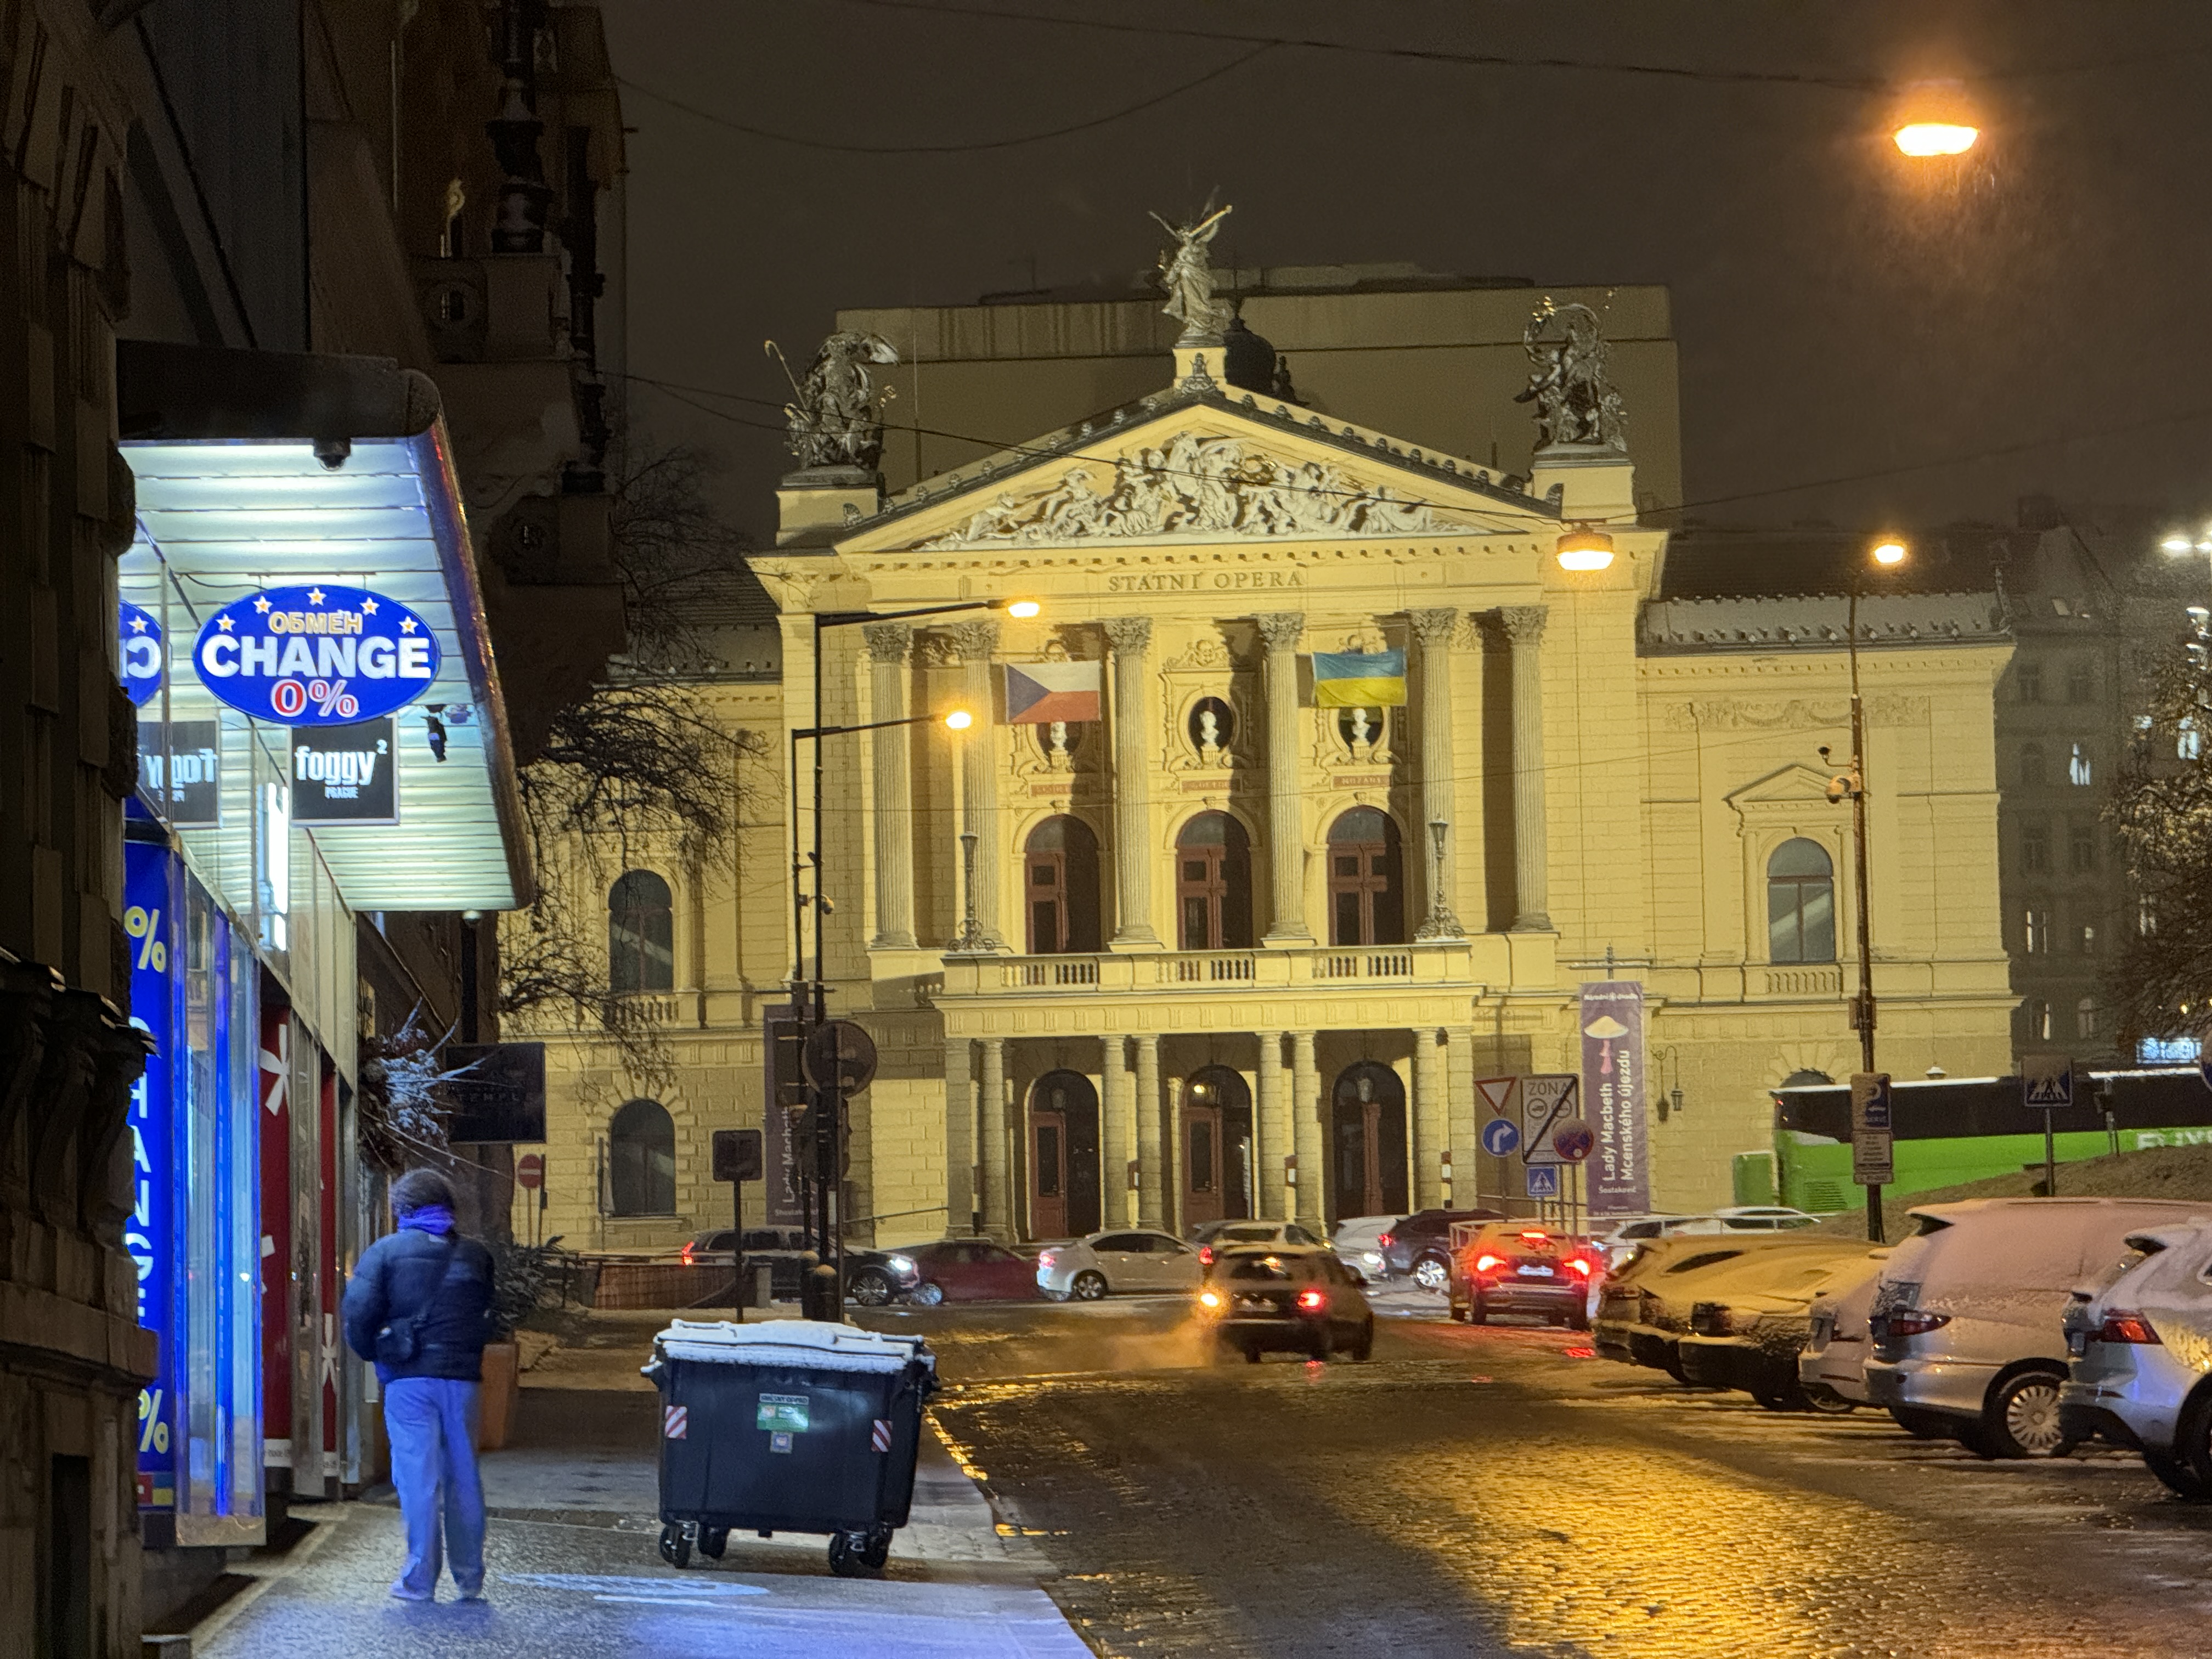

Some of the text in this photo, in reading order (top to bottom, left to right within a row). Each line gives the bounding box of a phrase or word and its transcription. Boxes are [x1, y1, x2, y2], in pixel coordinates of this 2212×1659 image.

[1108, 572, 1303, 591] STÁTNÍ OPERA
[268, 611, 363, 634] ОБМЕН
[201, 635, 432, 679] CHANGE
[270, 679, 359, 718] 0%
[1599, 1083, 1617, 1181] Lady Macbeth
[1617, 1050, 1634, 1180] Mcenského újezdu
